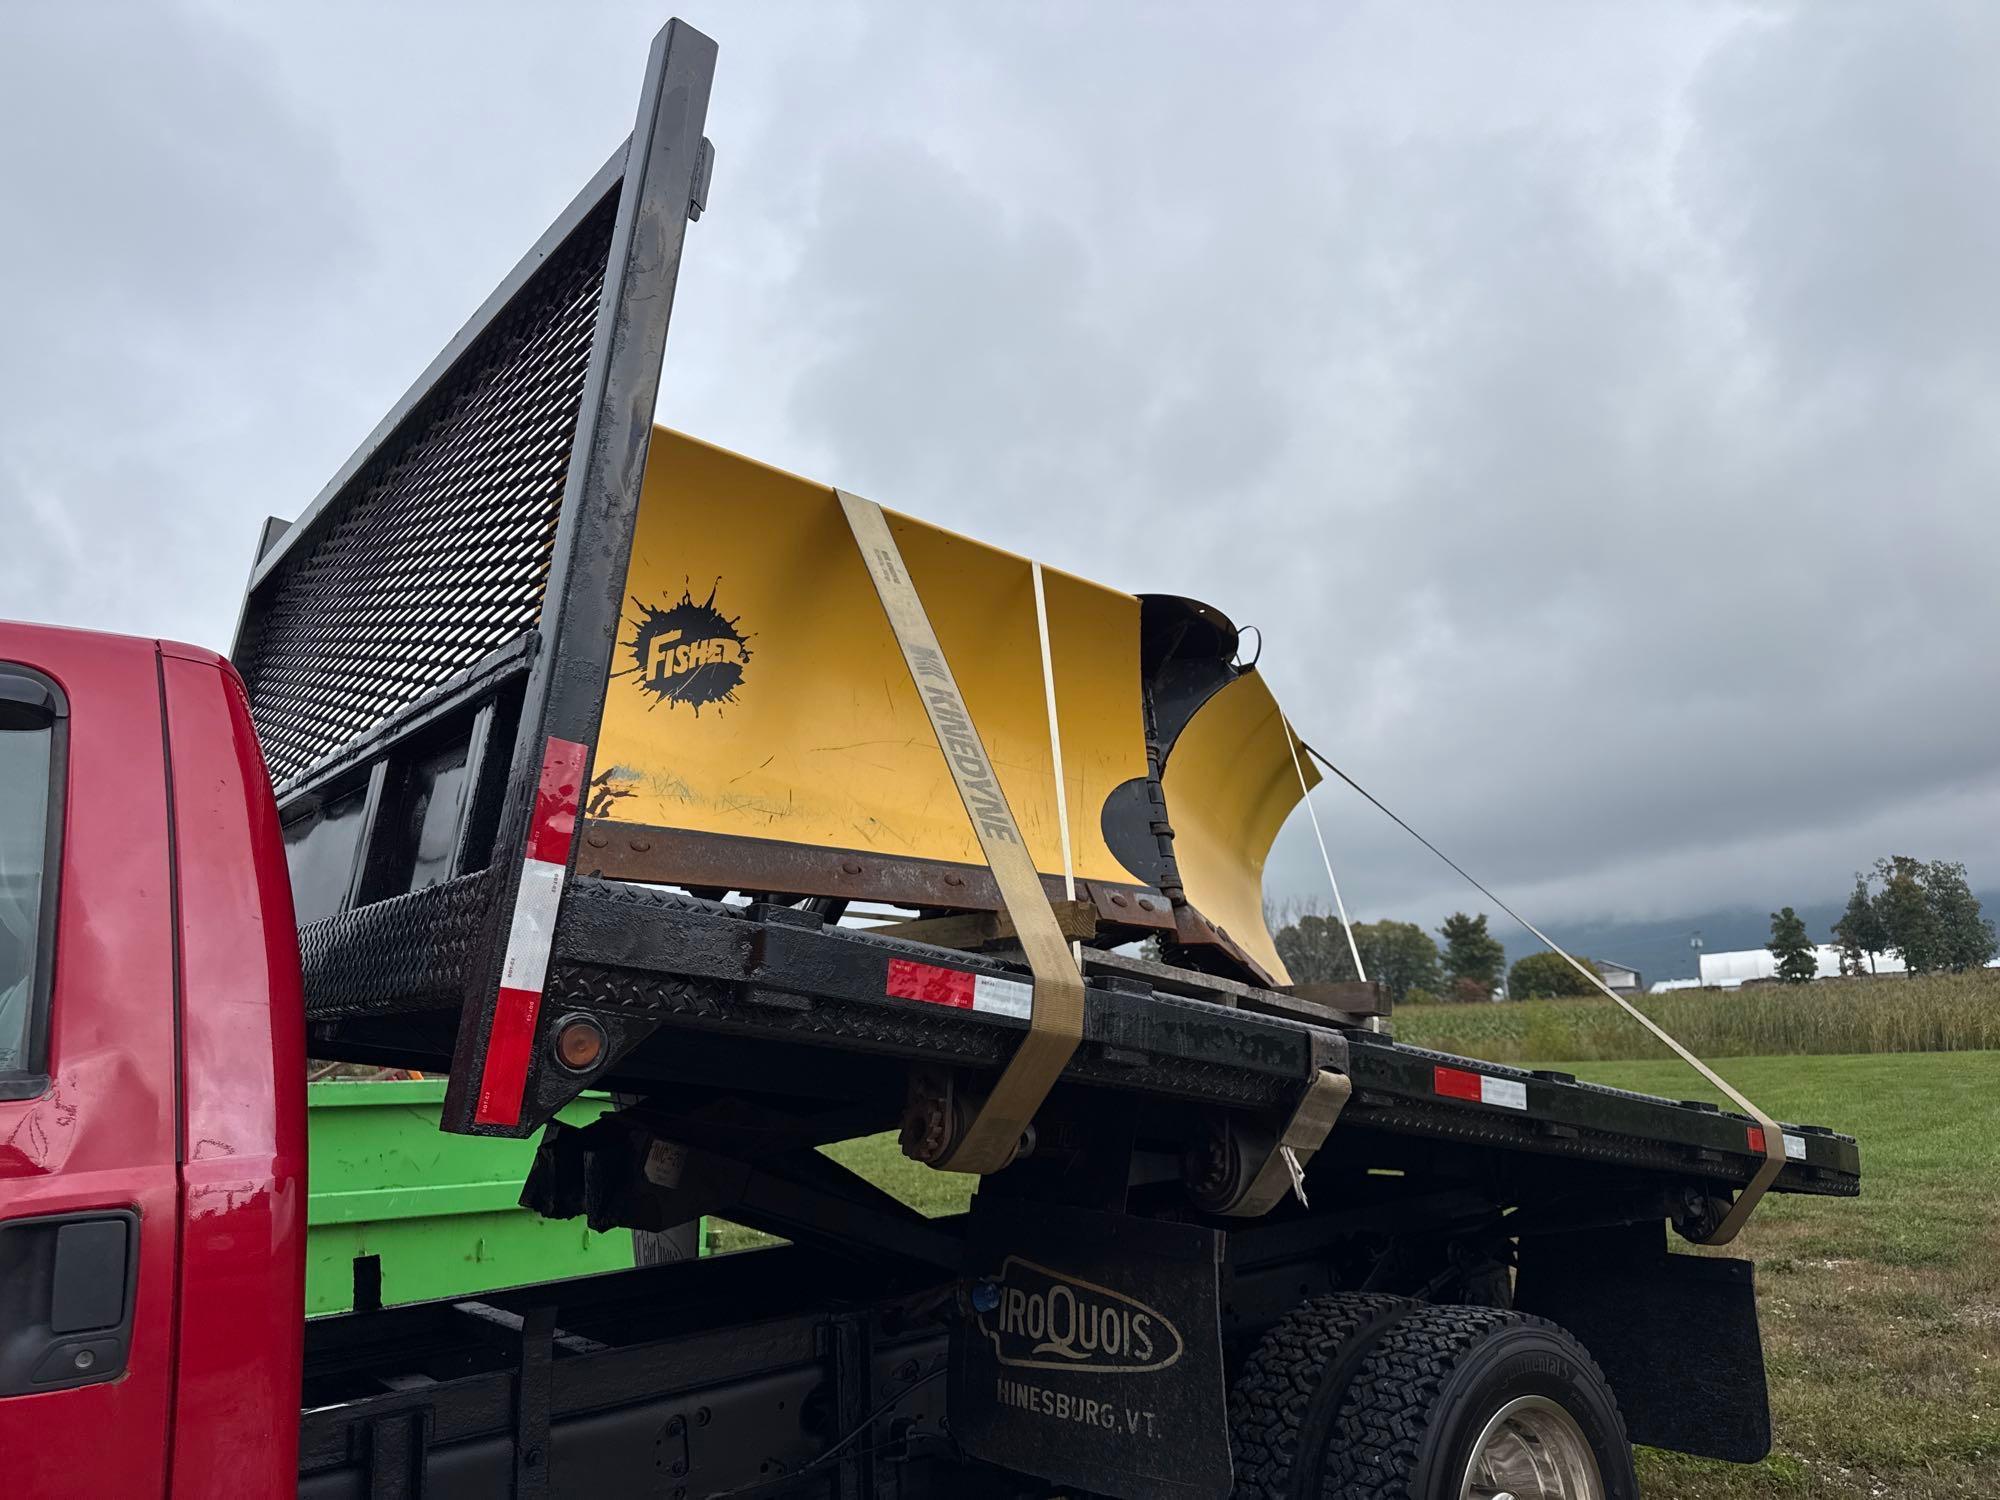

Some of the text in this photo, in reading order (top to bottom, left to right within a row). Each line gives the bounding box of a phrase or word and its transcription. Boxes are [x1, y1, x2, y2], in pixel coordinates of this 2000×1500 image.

[646, 629, 743, 681] FISHER
[925, 684, 1018, 845] KINEDYNE
[1000, 1285, 1153, 1360] IROQUOIS
